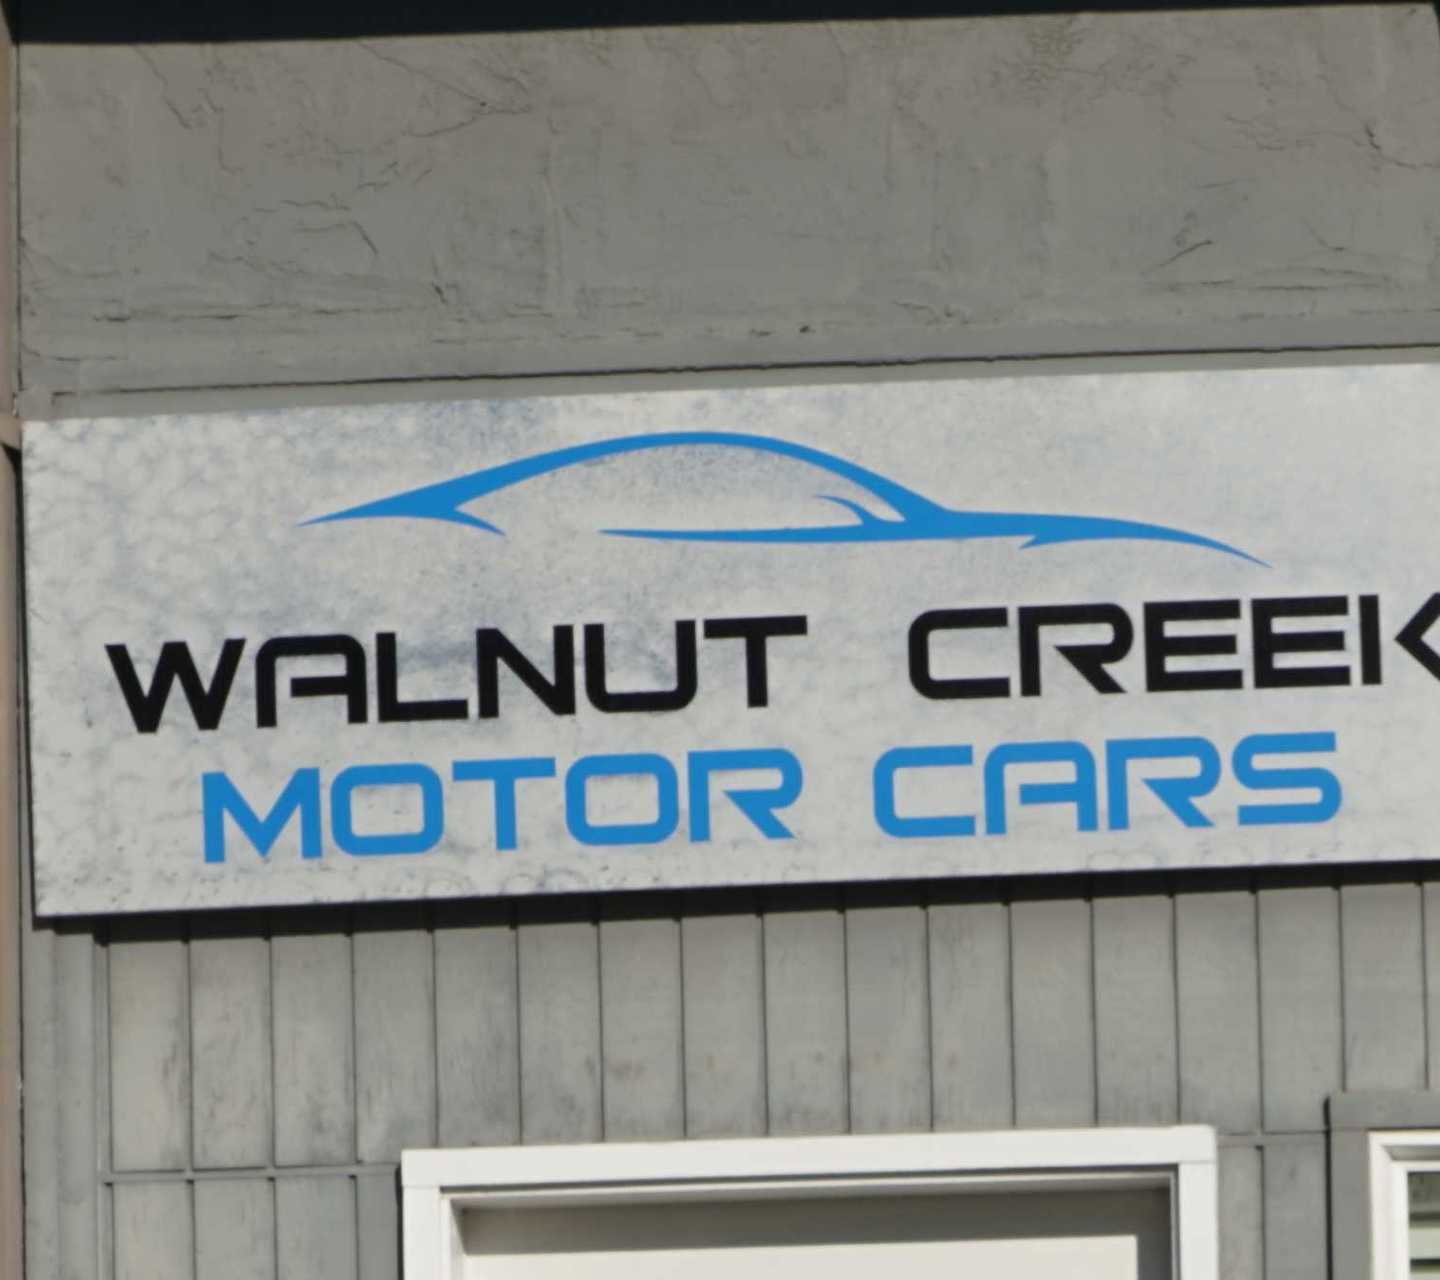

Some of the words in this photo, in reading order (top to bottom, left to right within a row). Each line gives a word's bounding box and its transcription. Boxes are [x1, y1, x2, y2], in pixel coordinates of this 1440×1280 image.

[104, 614, 808, 734] WALNUT
[200, 747, 805, 865] MOTOR
[872, 729, 1345, 839] CARS
